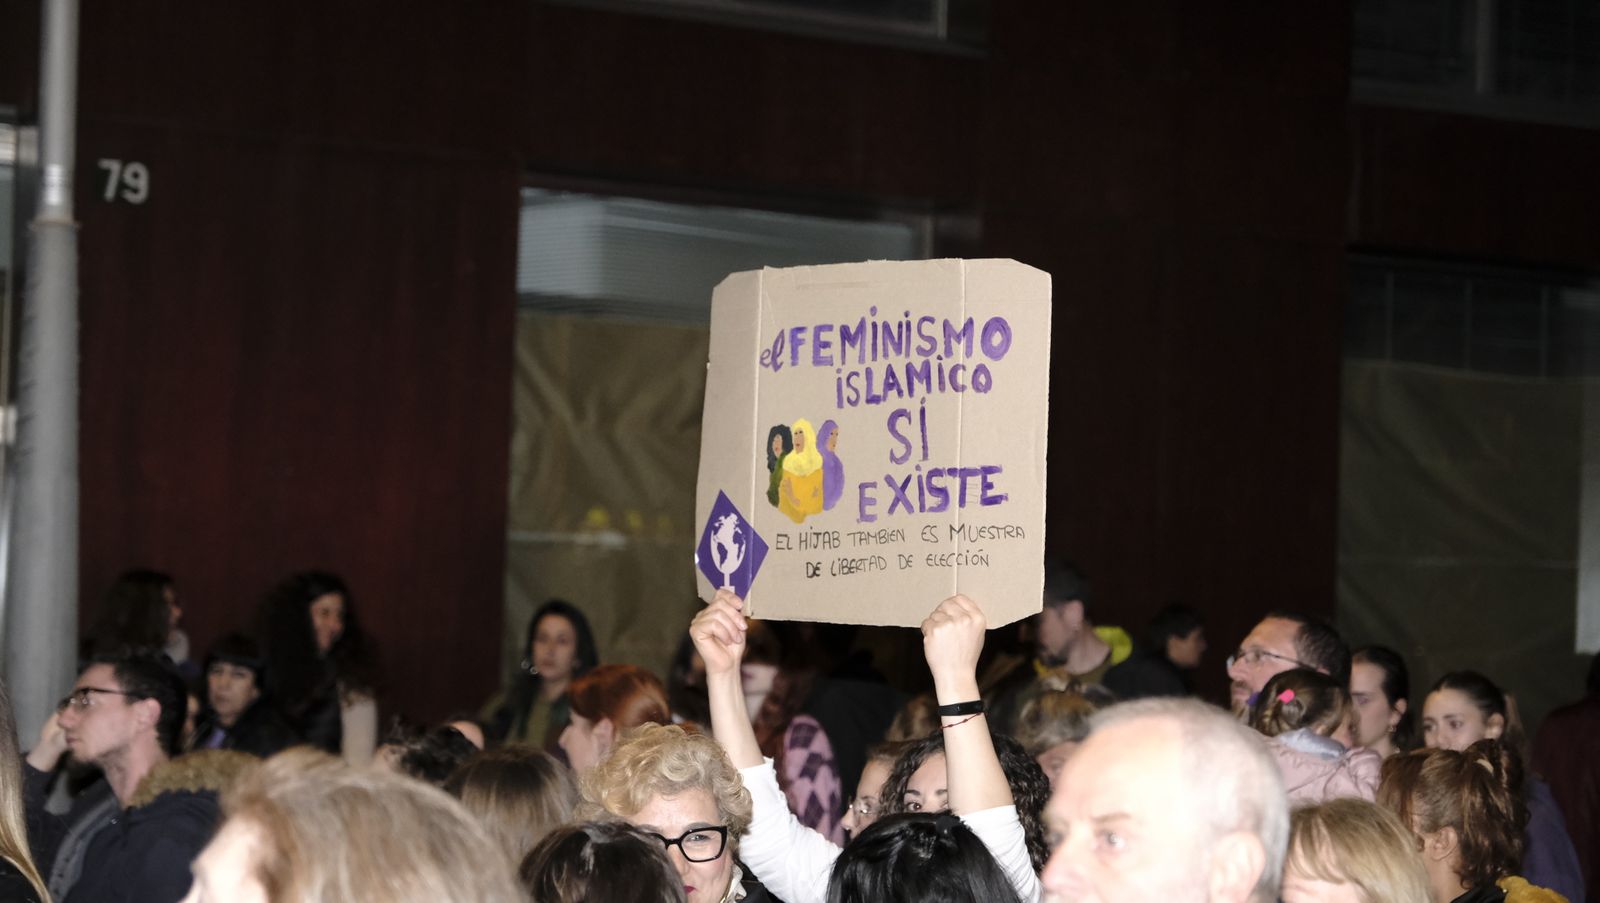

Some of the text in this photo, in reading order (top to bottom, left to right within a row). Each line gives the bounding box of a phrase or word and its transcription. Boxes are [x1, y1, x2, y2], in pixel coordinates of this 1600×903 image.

[98, 159, 149, 204] 79
[759, 328, 785, 373] el
[921, 524, 939, 543] ES
[949, 523, 1025, 543] MUESTRA
[806, 562, 822, 579] DE
[898, 553, 914, 570] DE
